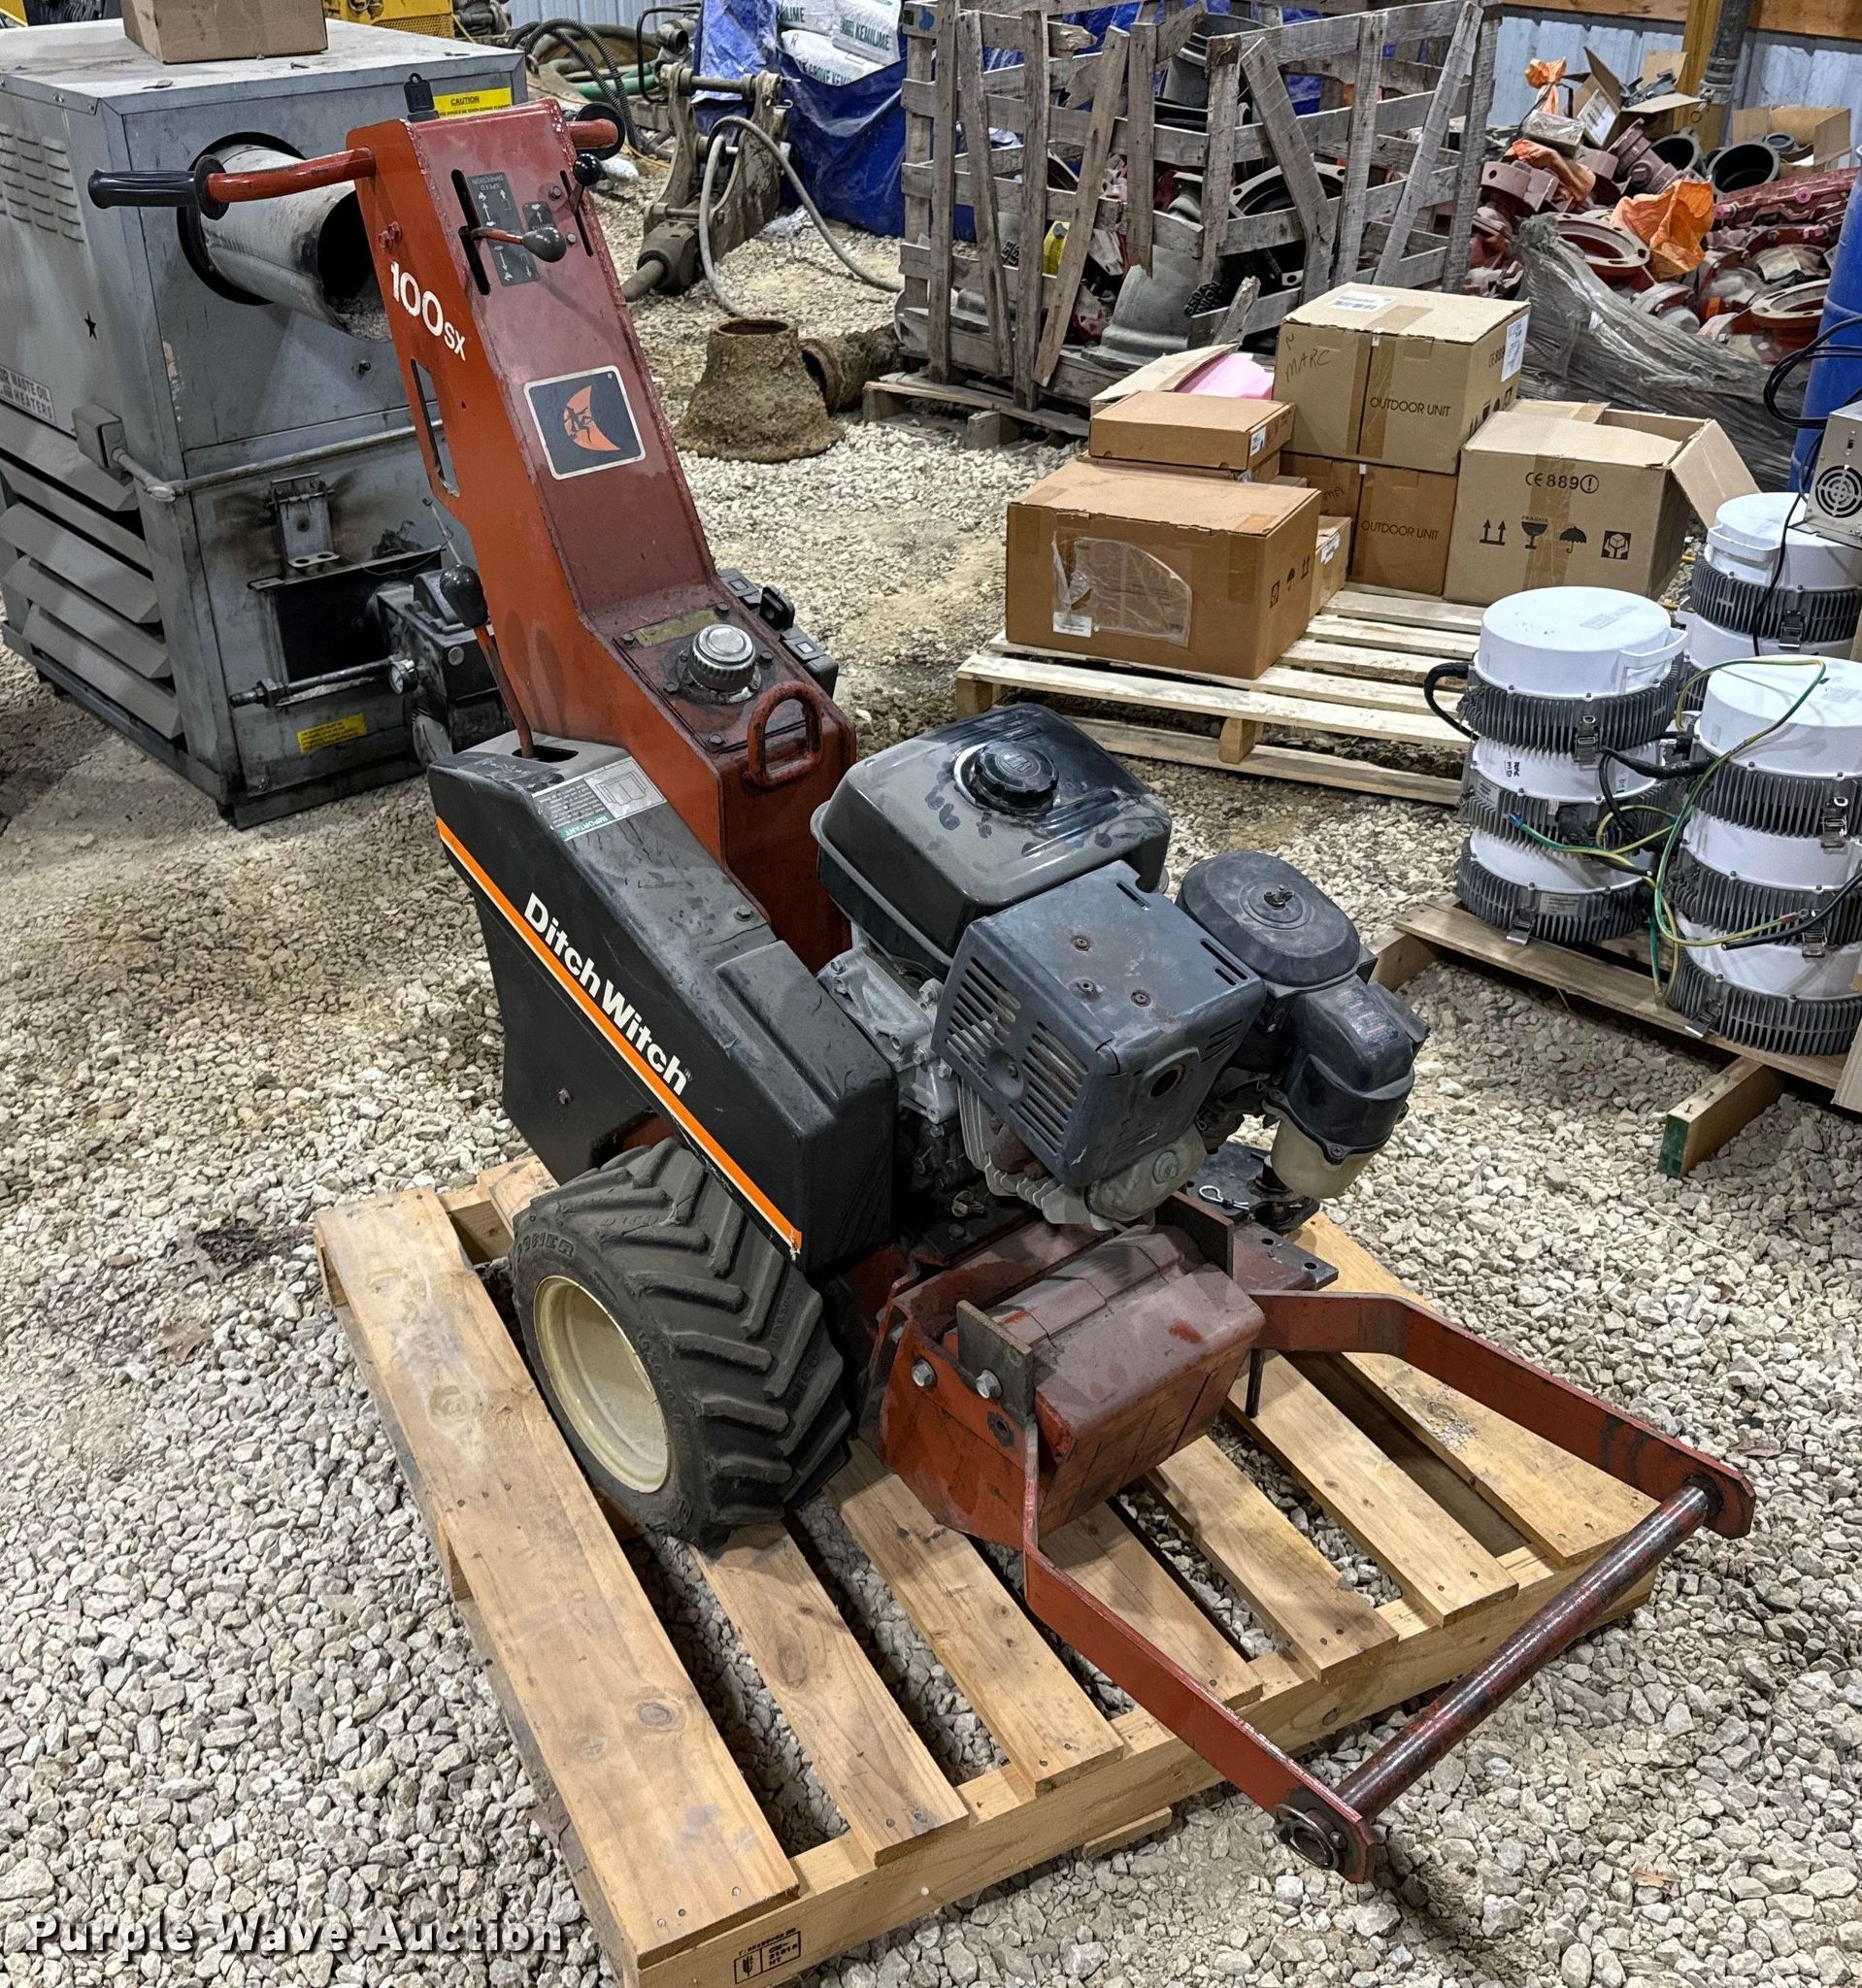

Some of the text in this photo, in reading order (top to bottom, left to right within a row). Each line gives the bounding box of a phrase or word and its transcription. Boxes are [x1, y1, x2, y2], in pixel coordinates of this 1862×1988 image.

[855, 21, 890, 51] KEMILIME
[450, 95, 480, 106] CAUTION
[1369, 396, 1451, 417] OUTDOOR UNIT
[1361, 520, 1440, 541] OUTDOOR UNIT
[564, 815, 609, 837] IMPORTANT
